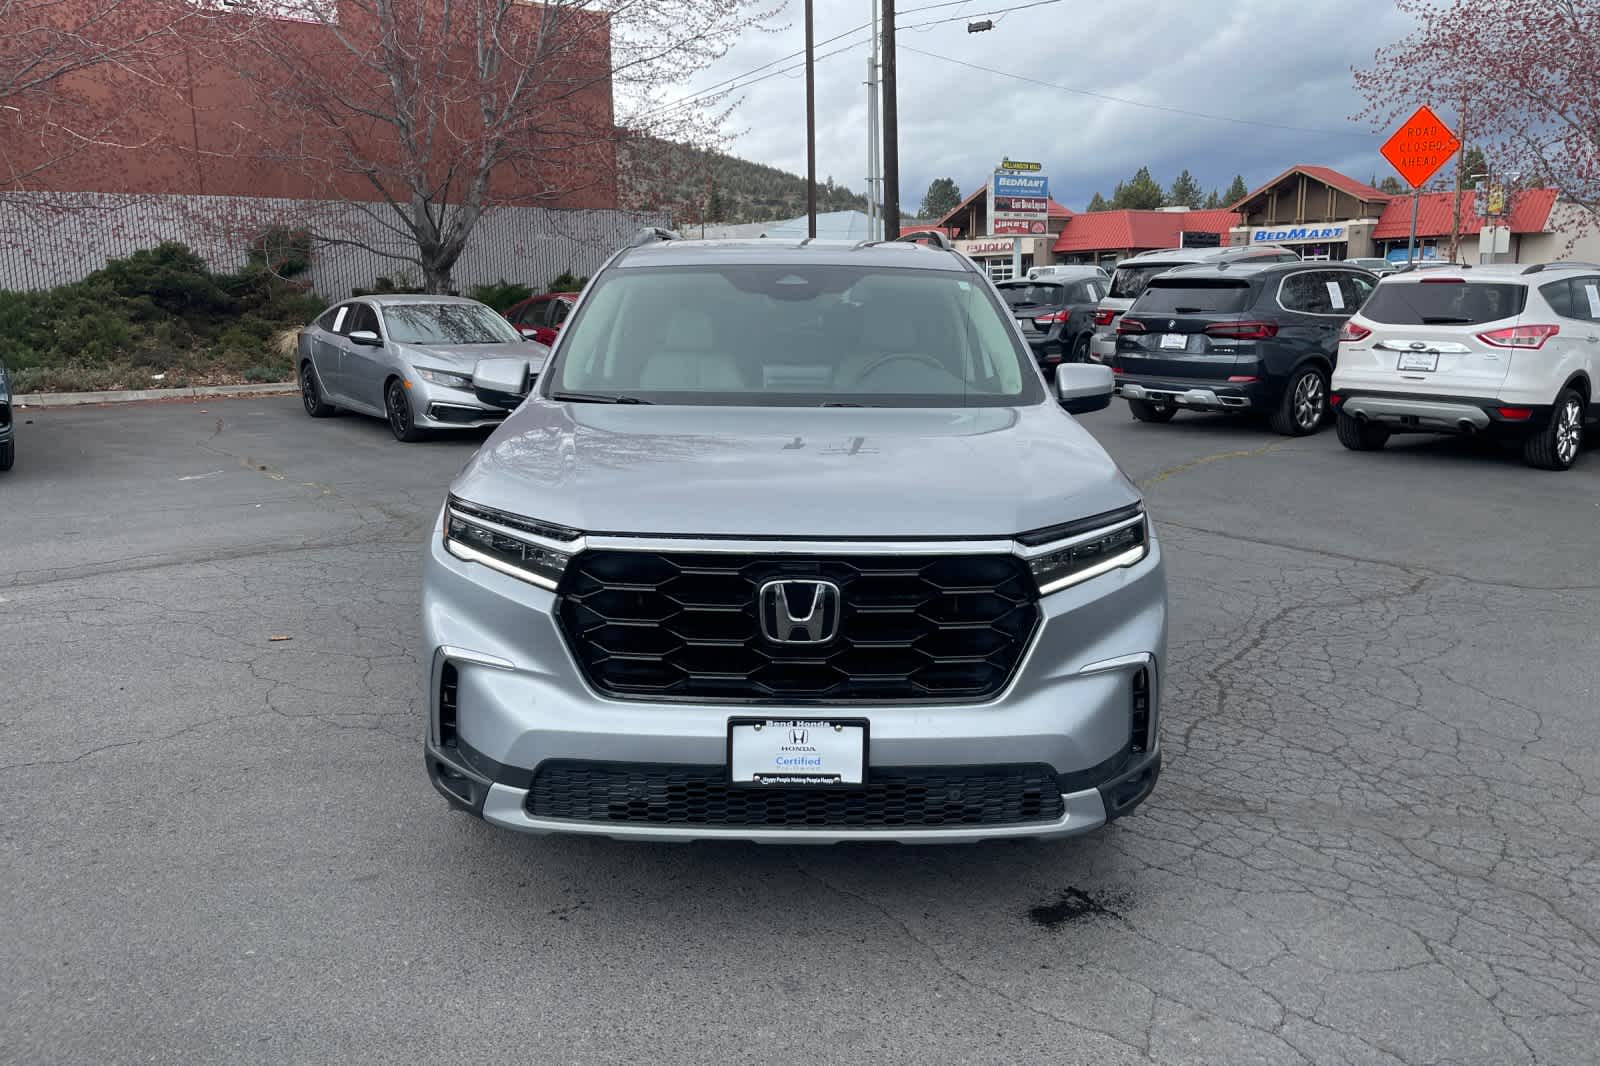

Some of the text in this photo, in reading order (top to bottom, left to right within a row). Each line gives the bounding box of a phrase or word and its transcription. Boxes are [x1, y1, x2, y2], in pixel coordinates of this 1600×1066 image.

[1407, 127, 1437, 137] ROAD
[1400, 141, 1442, 152] CLOSED
[1401, 156, 1437, 168] AHEAD
[1254, 227, 1343, 240] BEDMART
[776, 756, 821, 766] Certified
